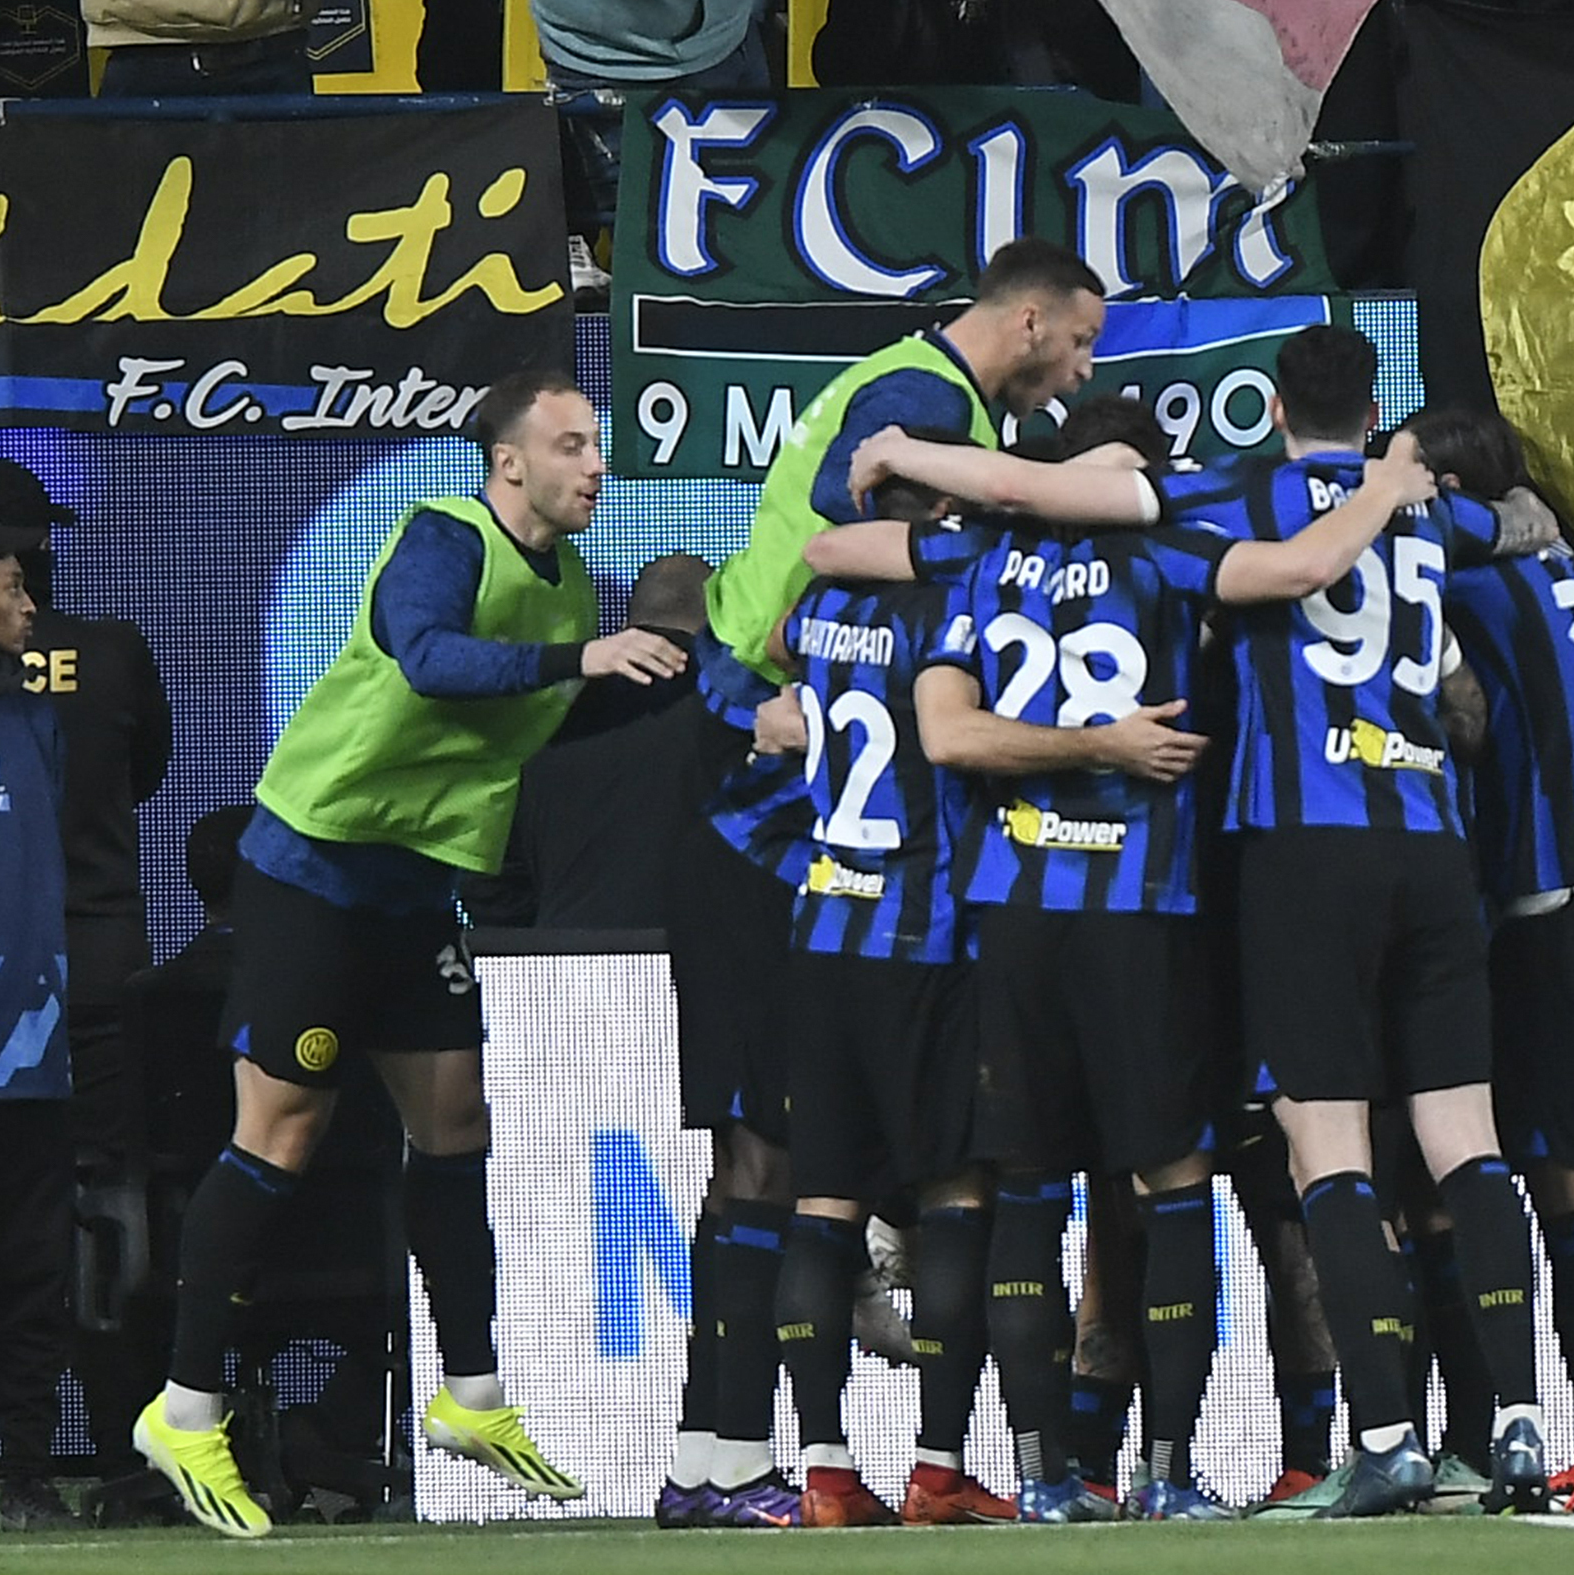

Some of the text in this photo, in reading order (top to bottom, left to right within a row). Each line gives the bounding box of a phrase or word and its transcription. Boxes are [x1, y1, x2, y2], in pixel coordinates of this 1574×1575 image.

[106, 356, 493, 434] F.C. Inter
[637, 381, 690, 467] 9
[1302, 535, 1446, 696] 95
[983, 611, 1148, 730] 28
